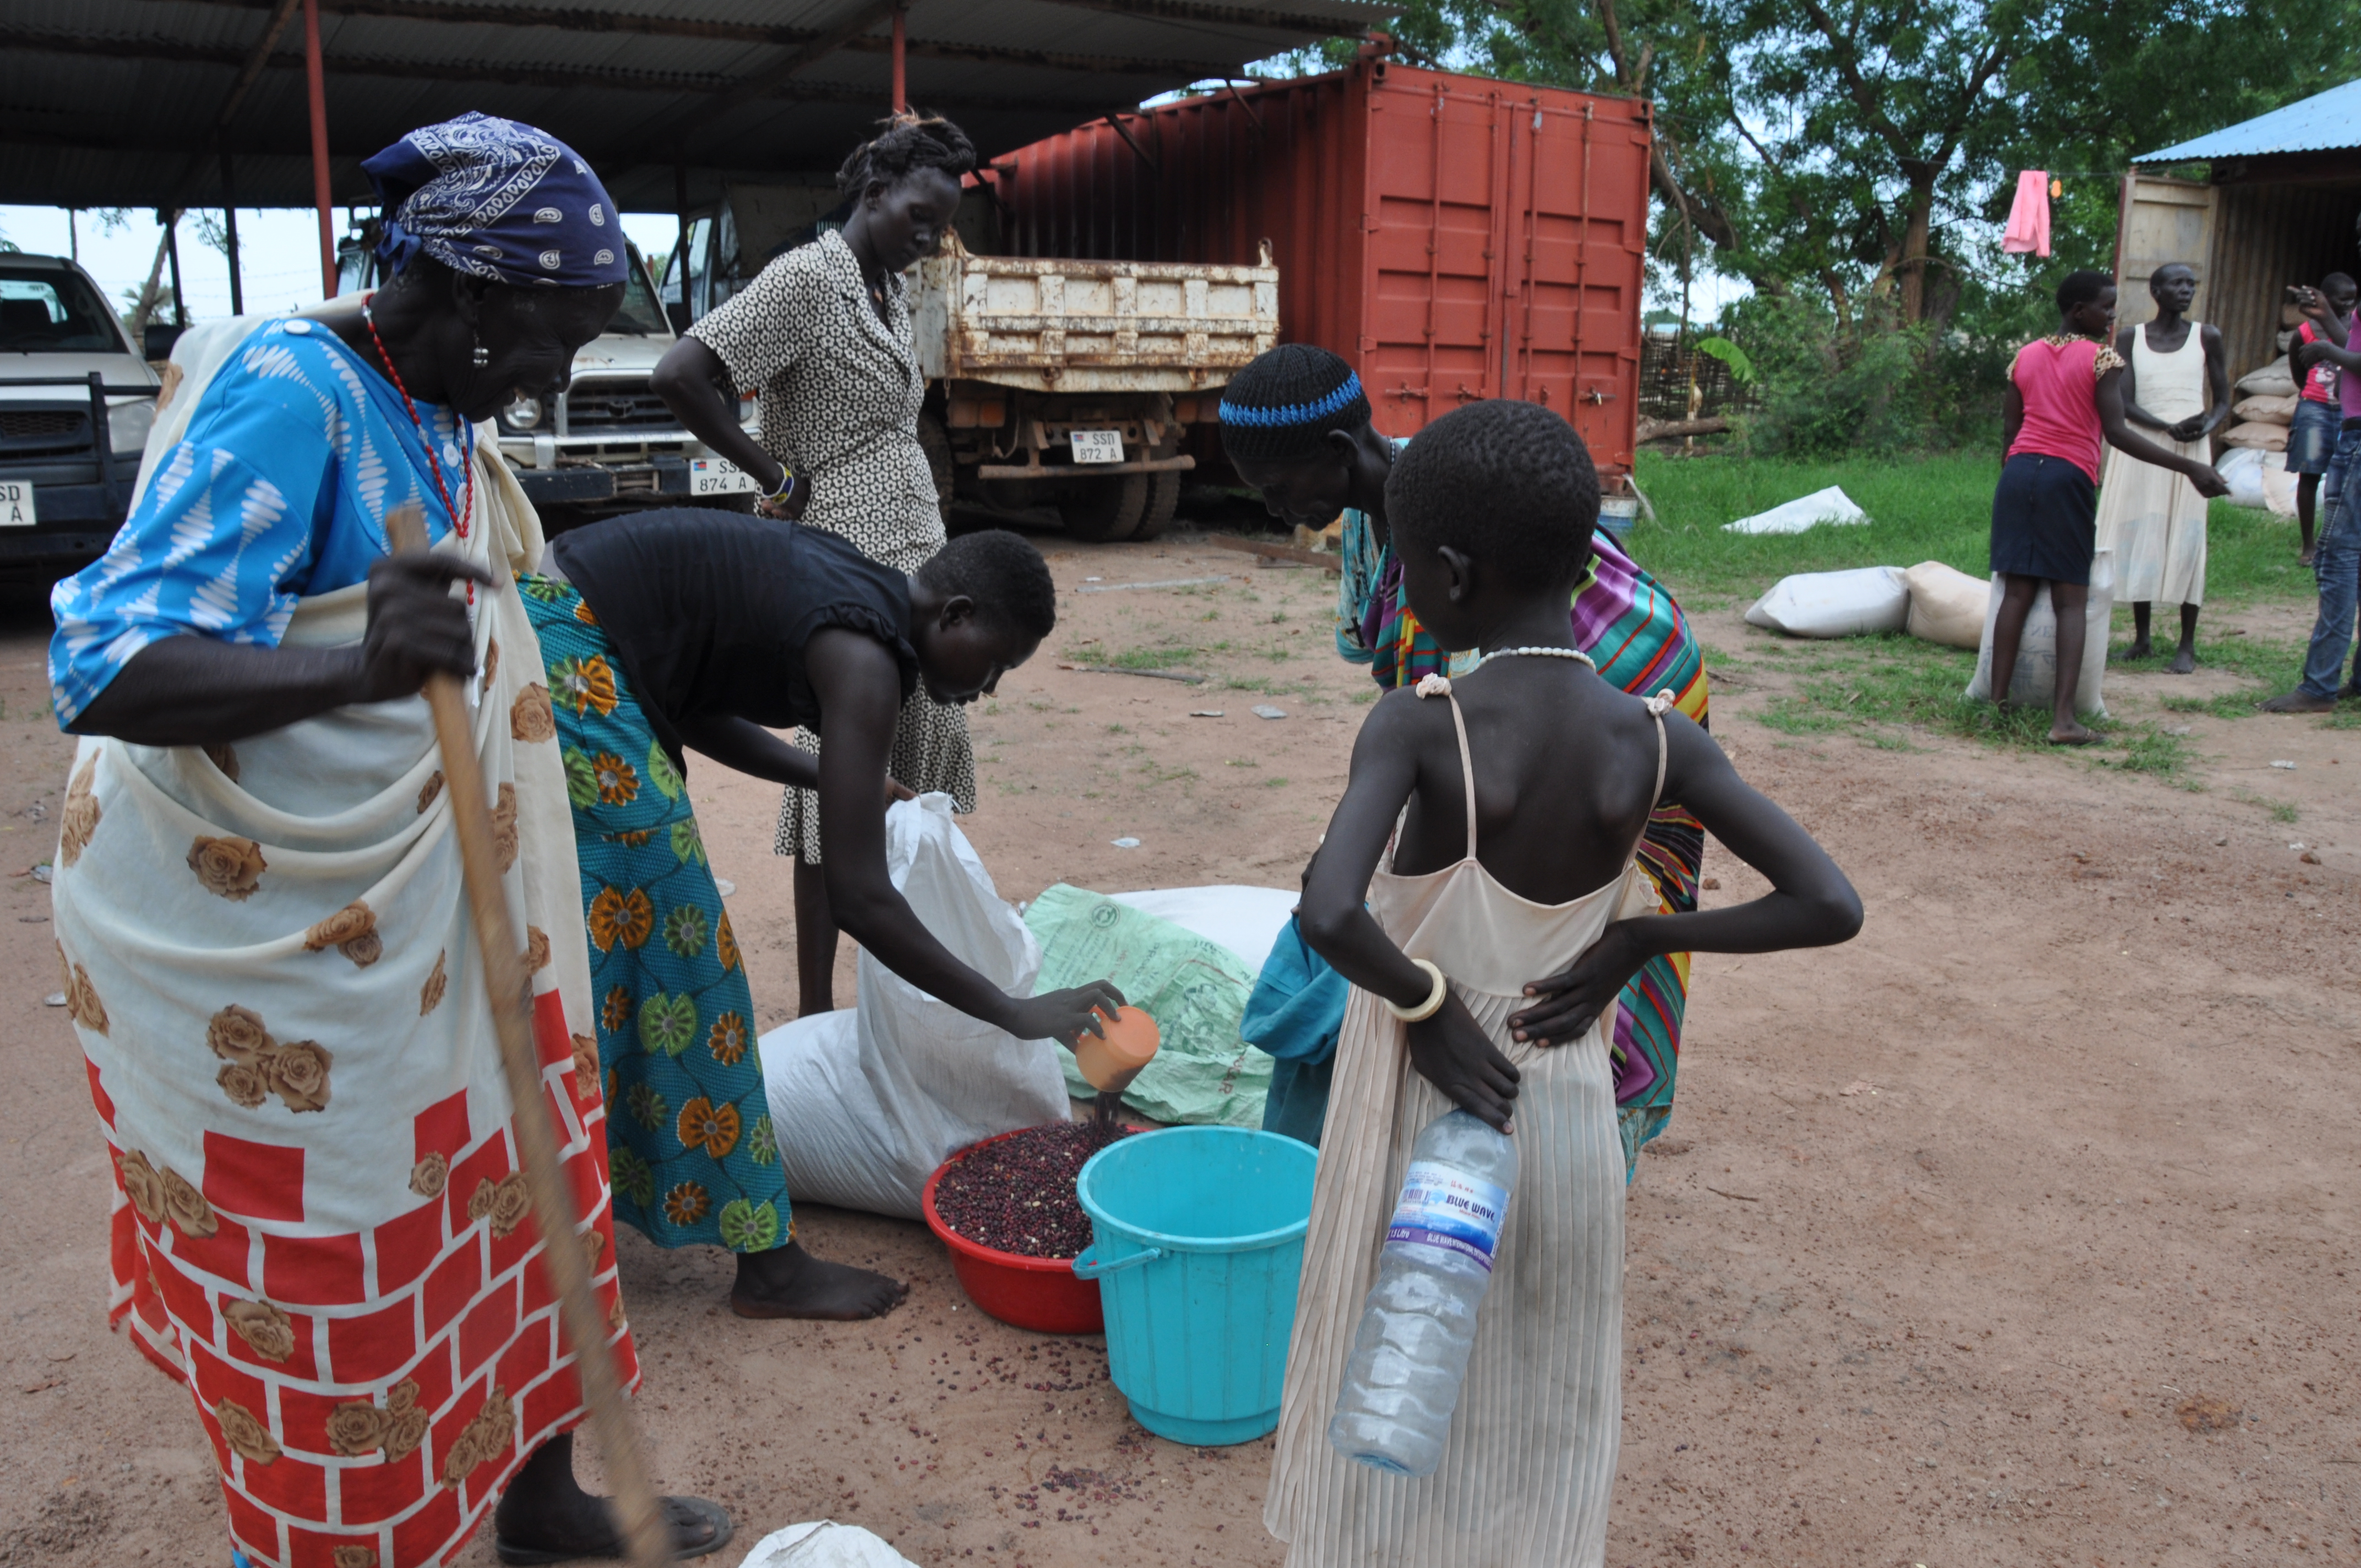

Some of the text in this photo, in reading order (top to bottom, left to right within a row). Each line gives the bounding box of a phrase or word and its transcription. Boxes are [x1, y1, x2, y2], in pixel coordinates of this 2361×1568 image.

[1080, 447, 1117, 460] 872 A
[719, 460, 743, 474] SS
[700, 476, 747, 492] 874 A
[11, 505, 23, 522] A
[1446, 1194, 1495, 1222] BLUE WAVE
[1427, 1233, 1440, 1243] BLUE
[1440, 1235, 1453, 1246] WAVE
